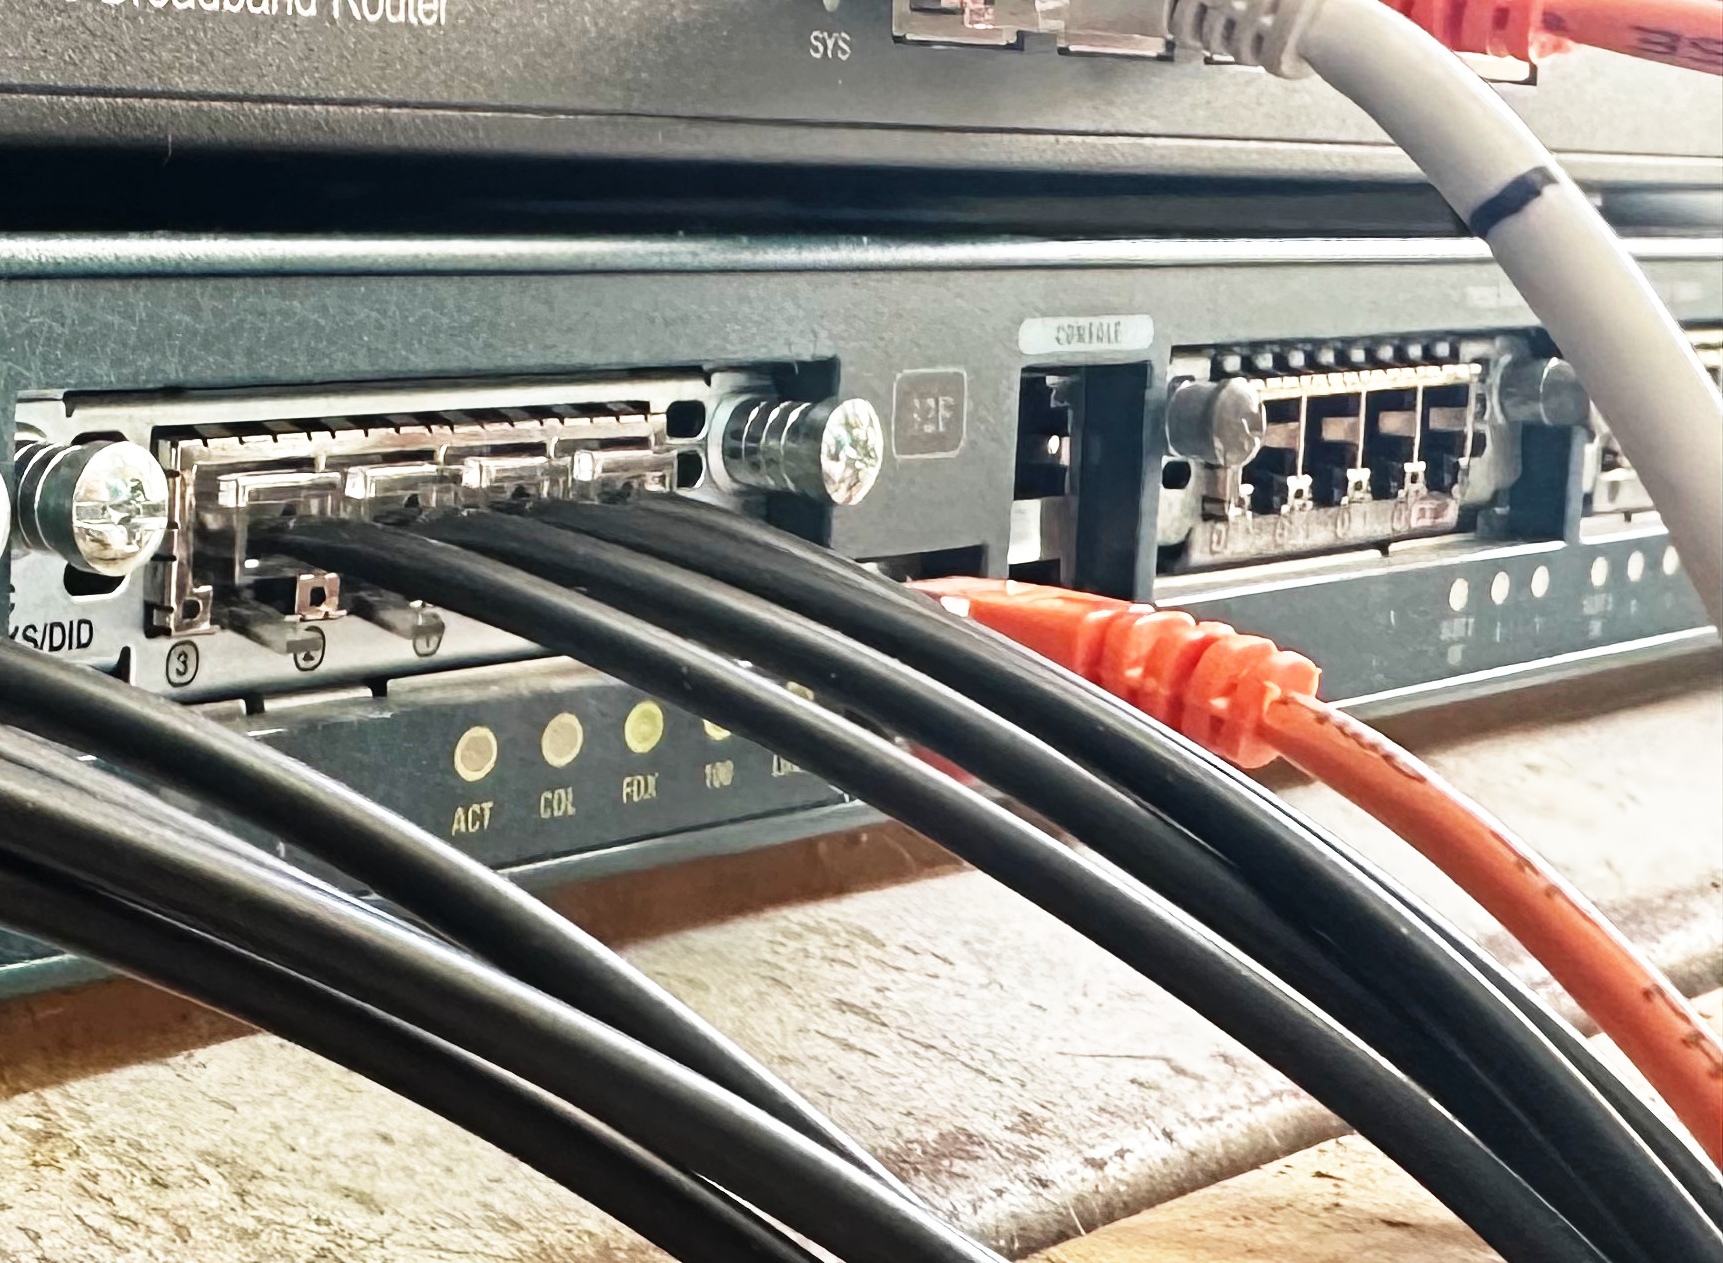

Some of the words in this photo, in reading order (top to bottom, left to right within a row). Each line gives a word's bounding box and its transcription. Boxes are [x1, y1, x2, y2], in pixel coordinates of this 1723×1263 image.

[809, 29, 852, 62] SYS
[622, 772, 660, 804] FDX
[452, 800, 495, 837] ACT
